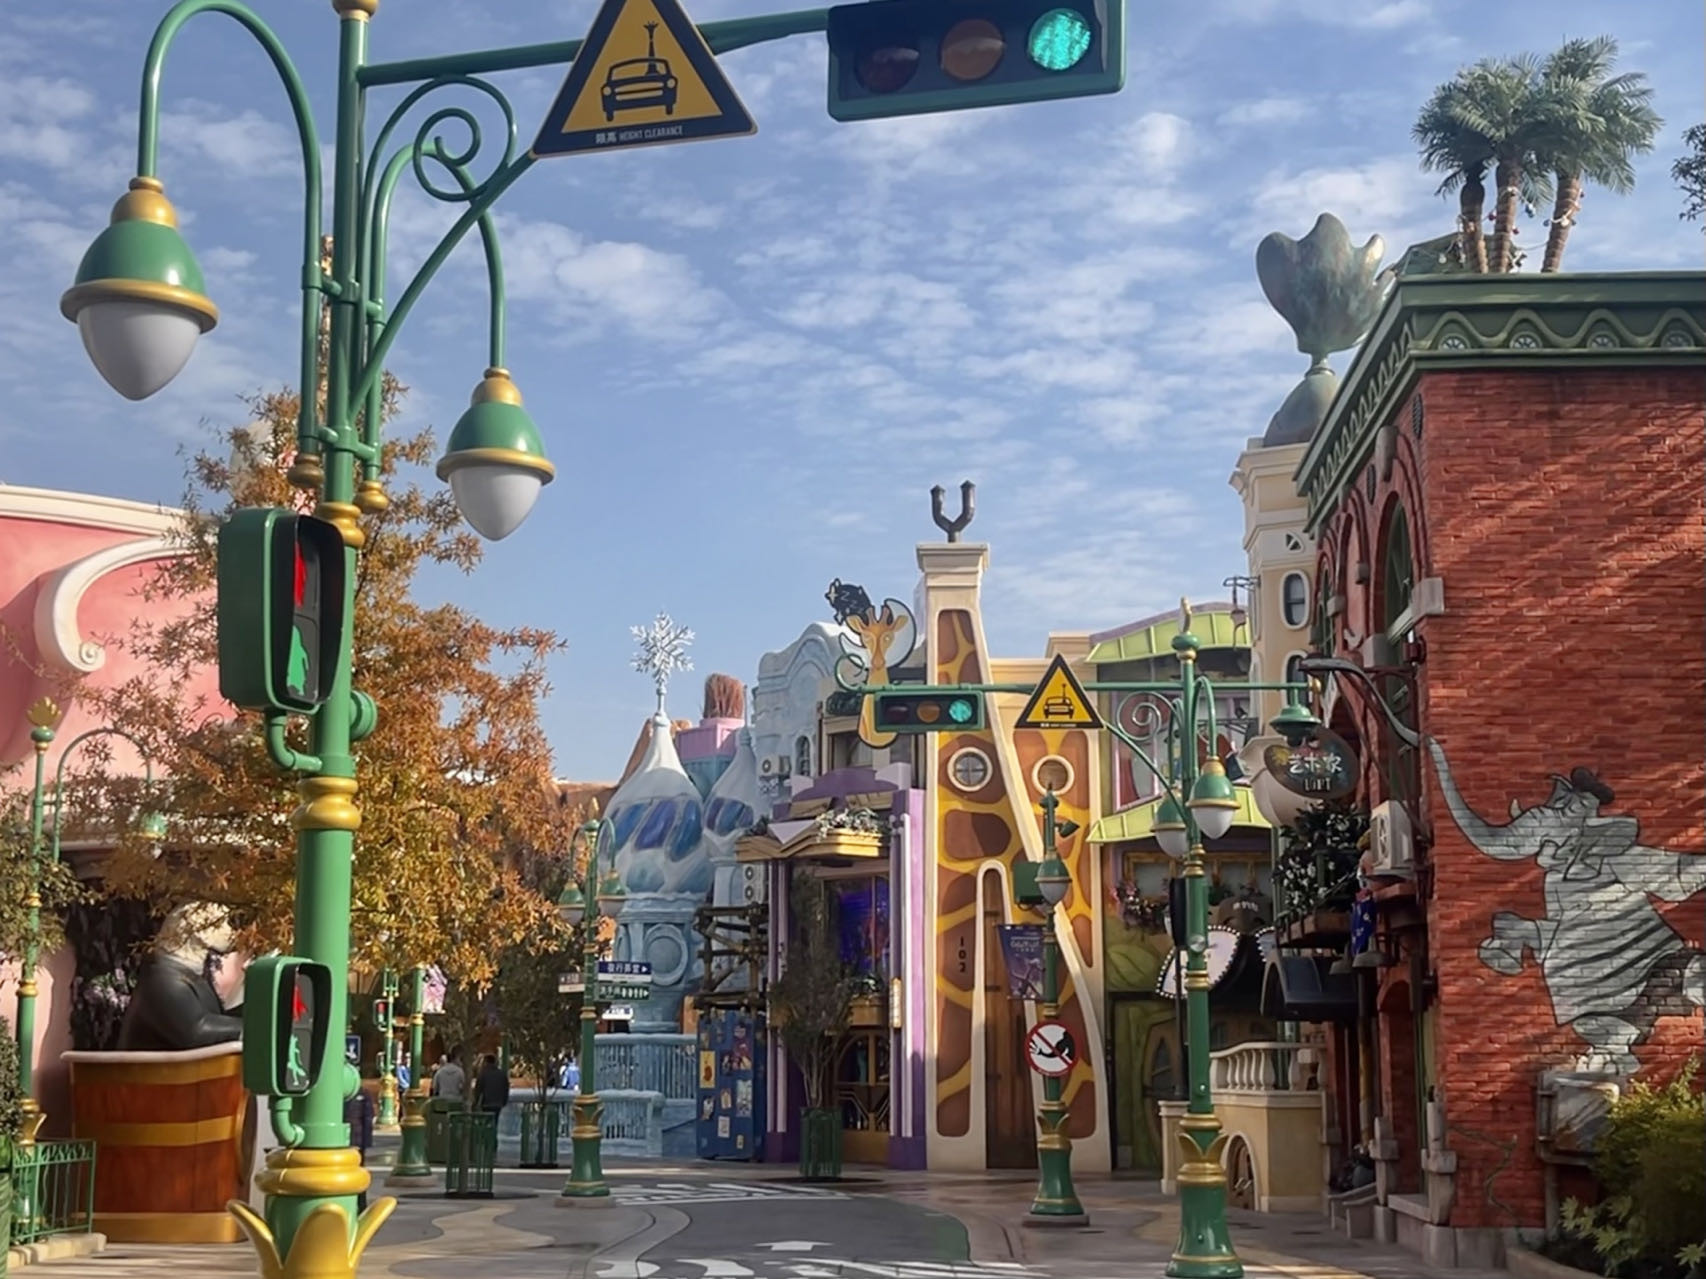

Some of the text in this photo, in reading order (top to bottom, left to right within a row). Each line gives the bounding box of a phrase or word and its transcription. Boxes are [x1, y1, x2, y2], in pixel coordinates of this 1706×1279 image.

[619, 129, 643, 141] HEIGHT
[644, 125, 683, 139] CLEARANCE
[1288, 751, 1343, 774] 艺术家
